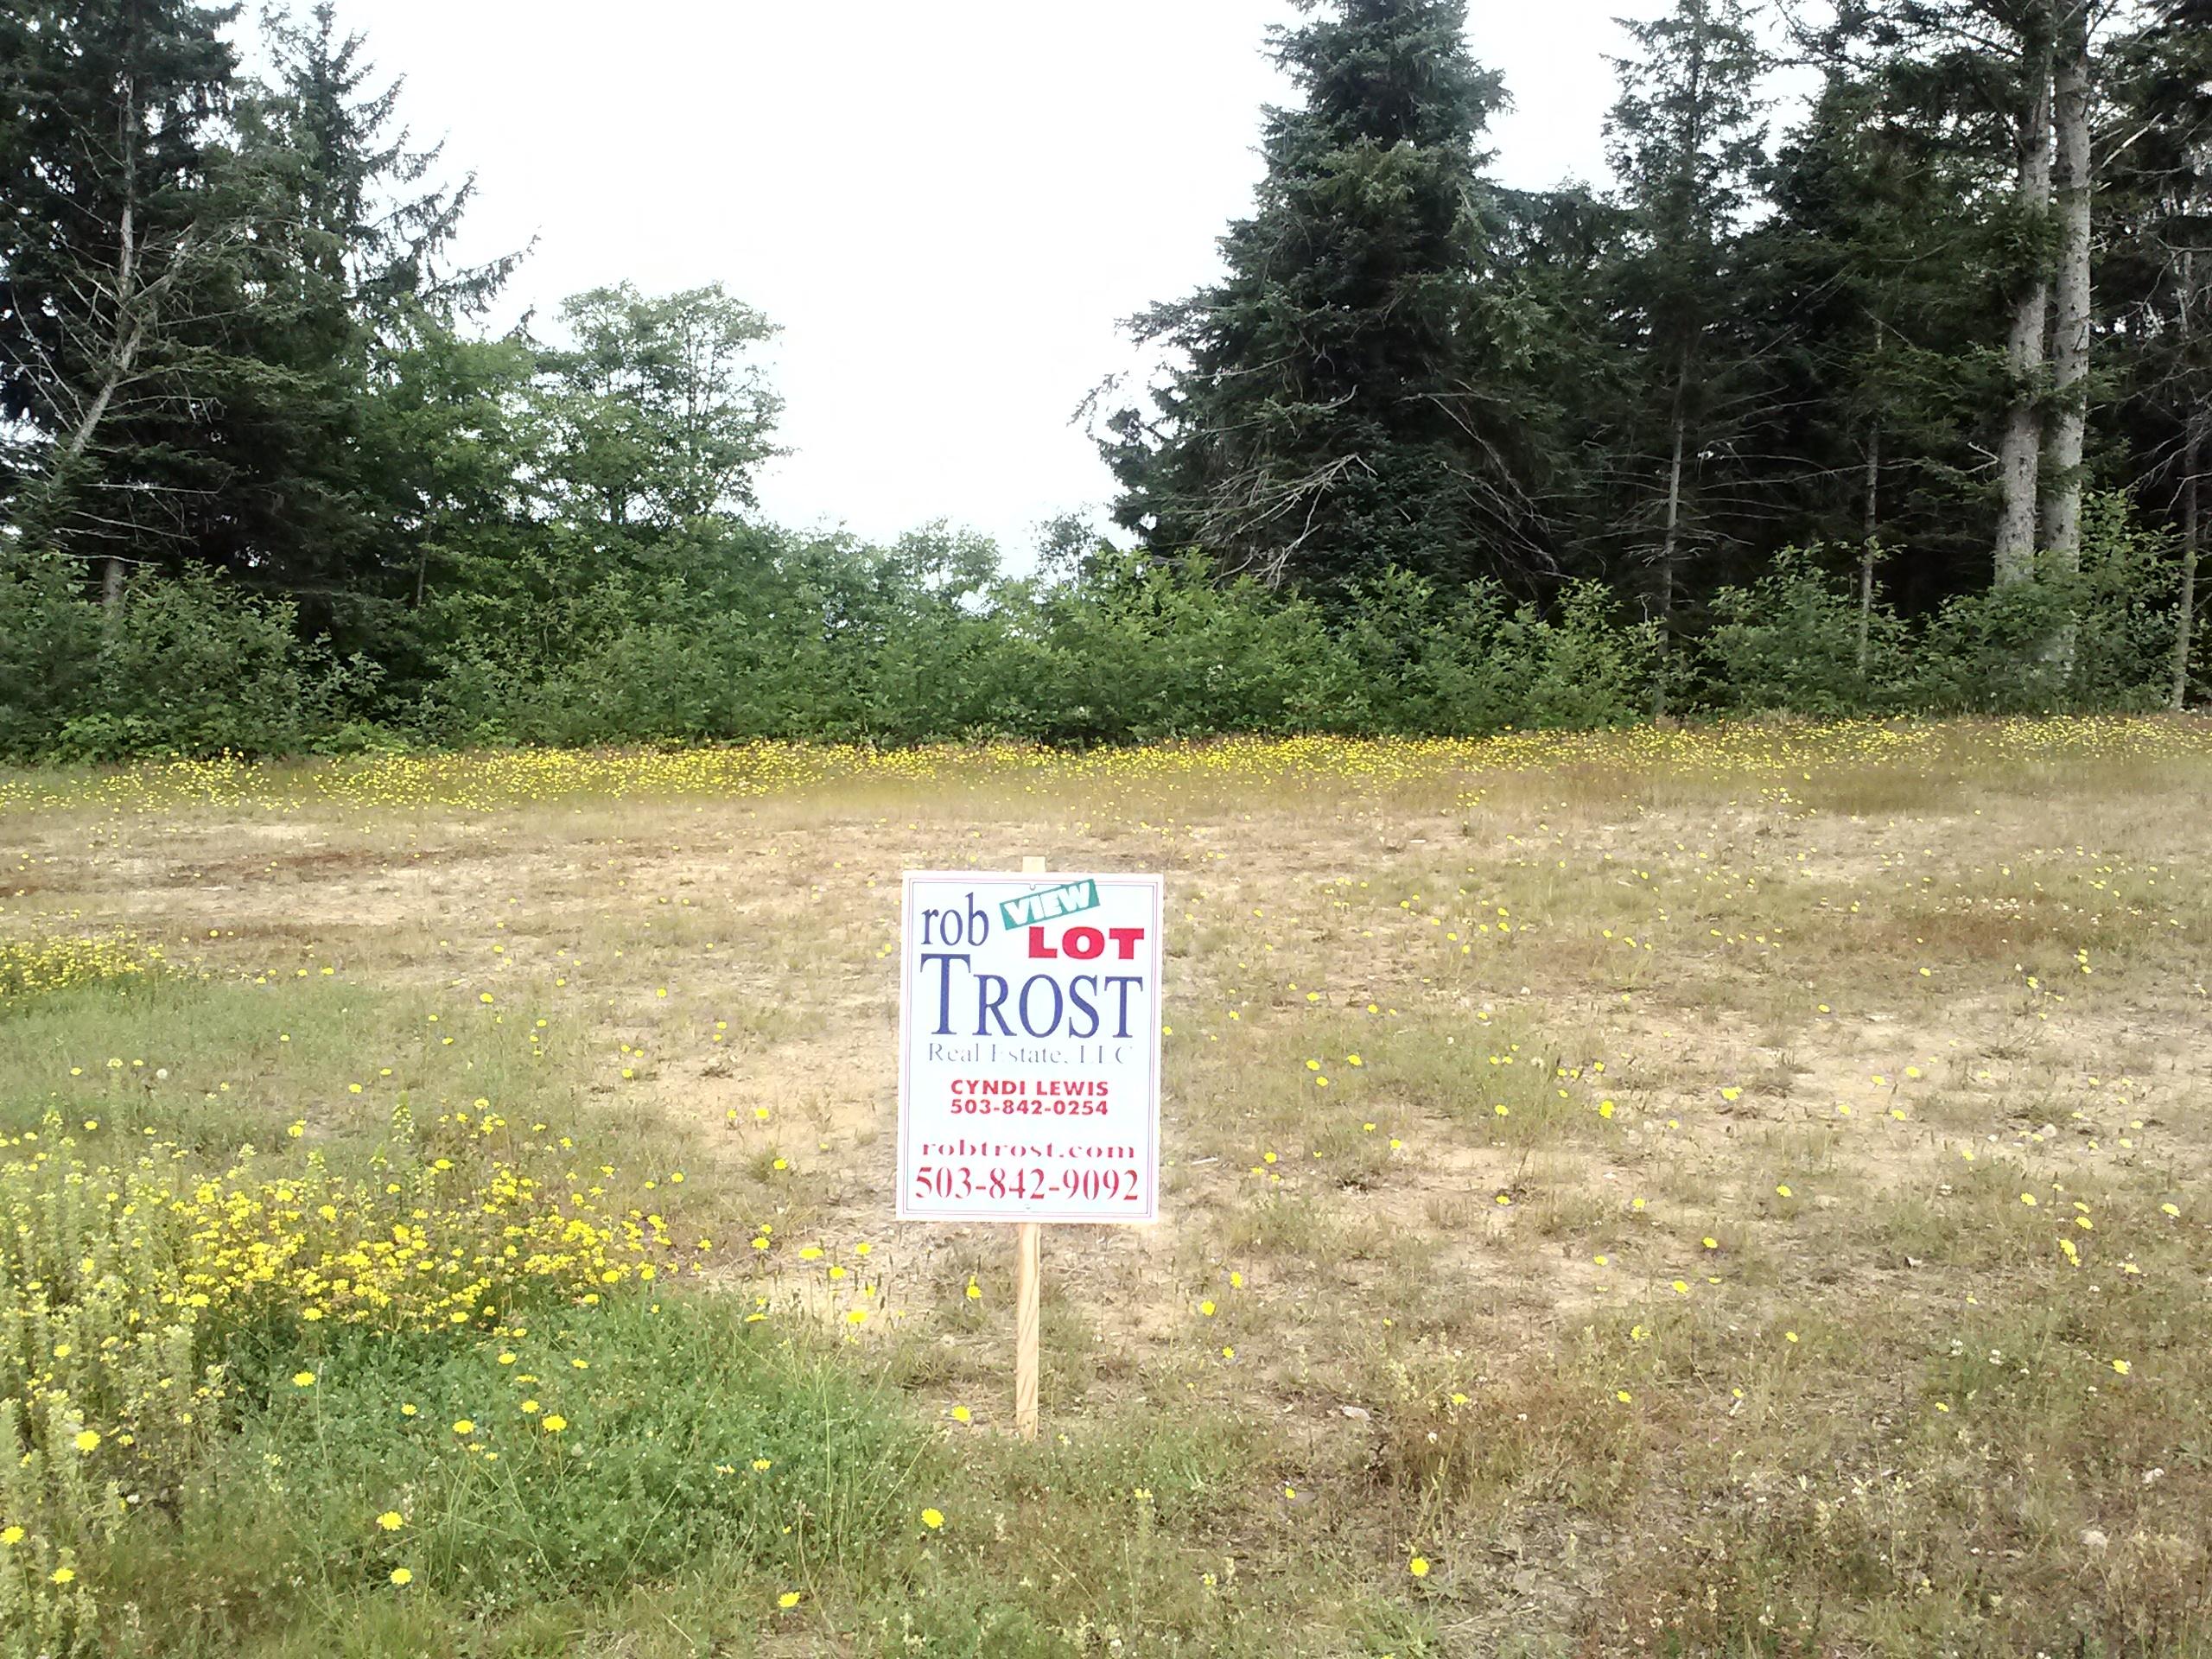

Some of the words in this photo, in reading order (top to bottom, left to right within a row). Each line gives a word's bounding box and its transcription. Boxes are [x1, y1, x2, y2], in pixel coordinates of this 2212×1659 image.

[920, 892, 989, 946] rob
[1002, 881, 1091, 925] VIEW
[1028, 926, 1145, 960] LOT
[919, 953, 1143, 1039] TROST
[929, 1043, 980, 1063] Real
[1079, 1045, 1133, 1065] LLC
[950, 1079, 1026, 1096] CYNDI
[1036, 1081, 1109, 1096] LEWIS
[950, 1098, 1109, 1116] 503-842-0254
[922, 1139, 1135, 1159] robtrost.com
[915, 1166, 1139, 1200] 503-842-9092
